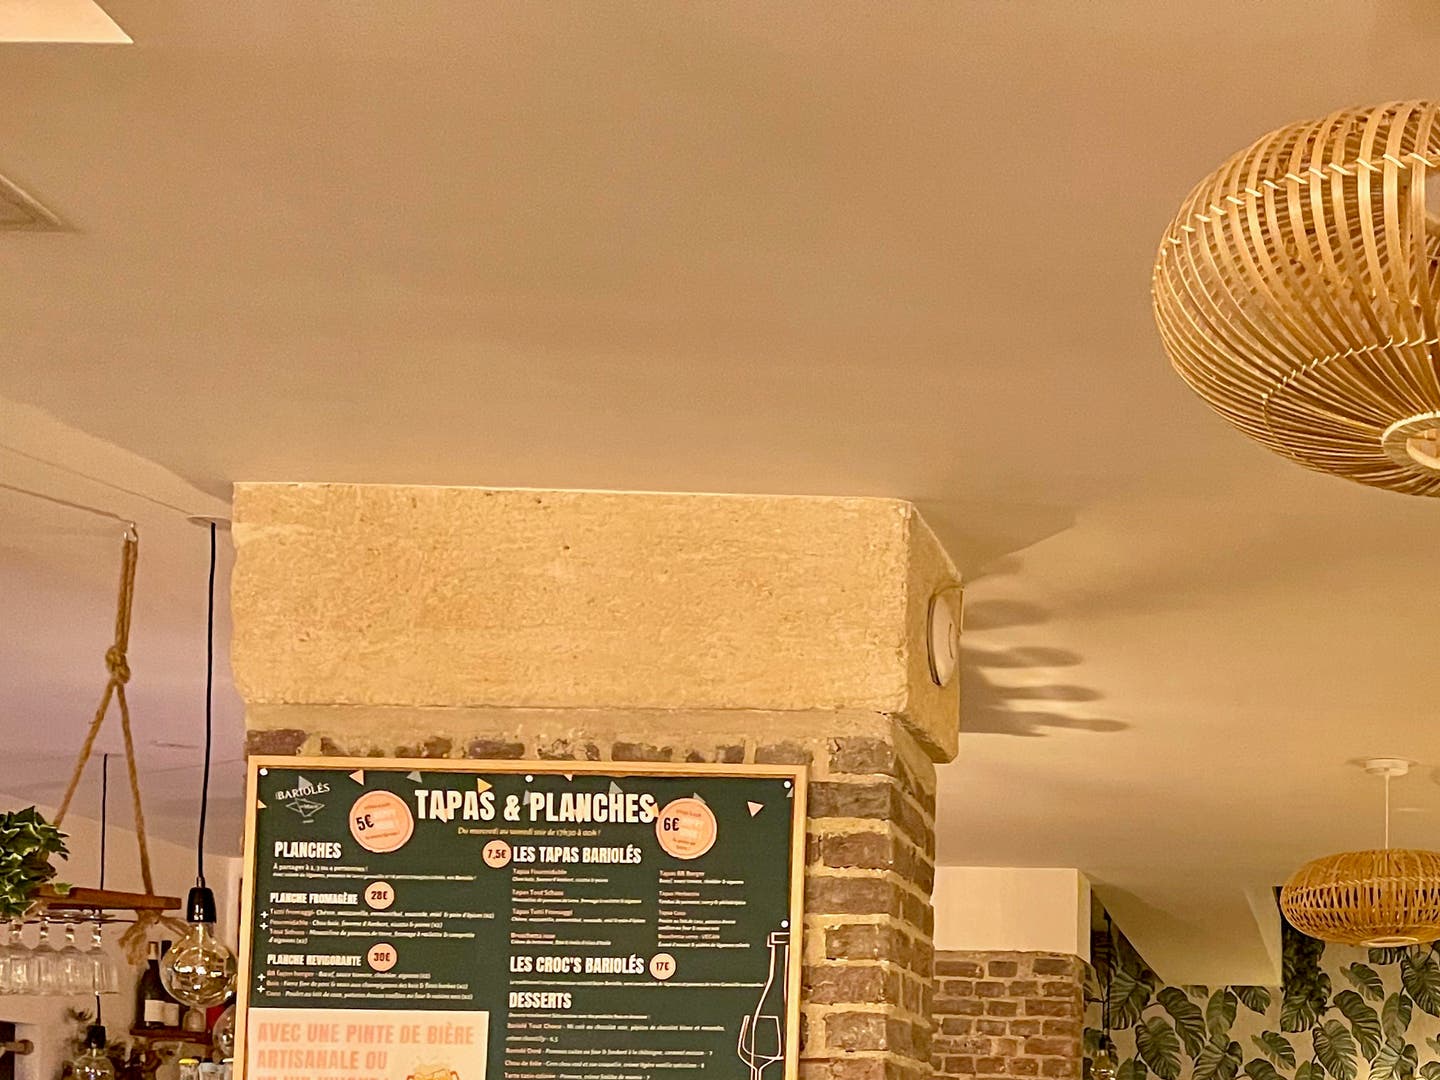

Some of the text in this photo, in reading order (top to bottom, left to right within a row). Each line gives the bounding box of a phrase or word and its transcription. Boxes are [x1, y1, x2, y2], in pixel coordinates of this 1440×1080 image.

[414, 789, 656, 823] TAPAS & PLANCHES
[356, 814, 375, 831] 5€
[663, 817, 680, 831] 6€
[274, 841, 342, 859] PLANCHES
[486, 849, 507, 859] 7,5€
[513, 844, 642, 864] LES TAPAS BARIOLÉS
[510, 954, 645, 974] LES CROC'S BARIOLÉS
[508, 991, 573, 1009] DESSERTS
[258, 1022, 475, 1045] AVEC UNE PINTE DE BIÈRE
[256, 1050, 388, 1071] ARTISANALE OU
